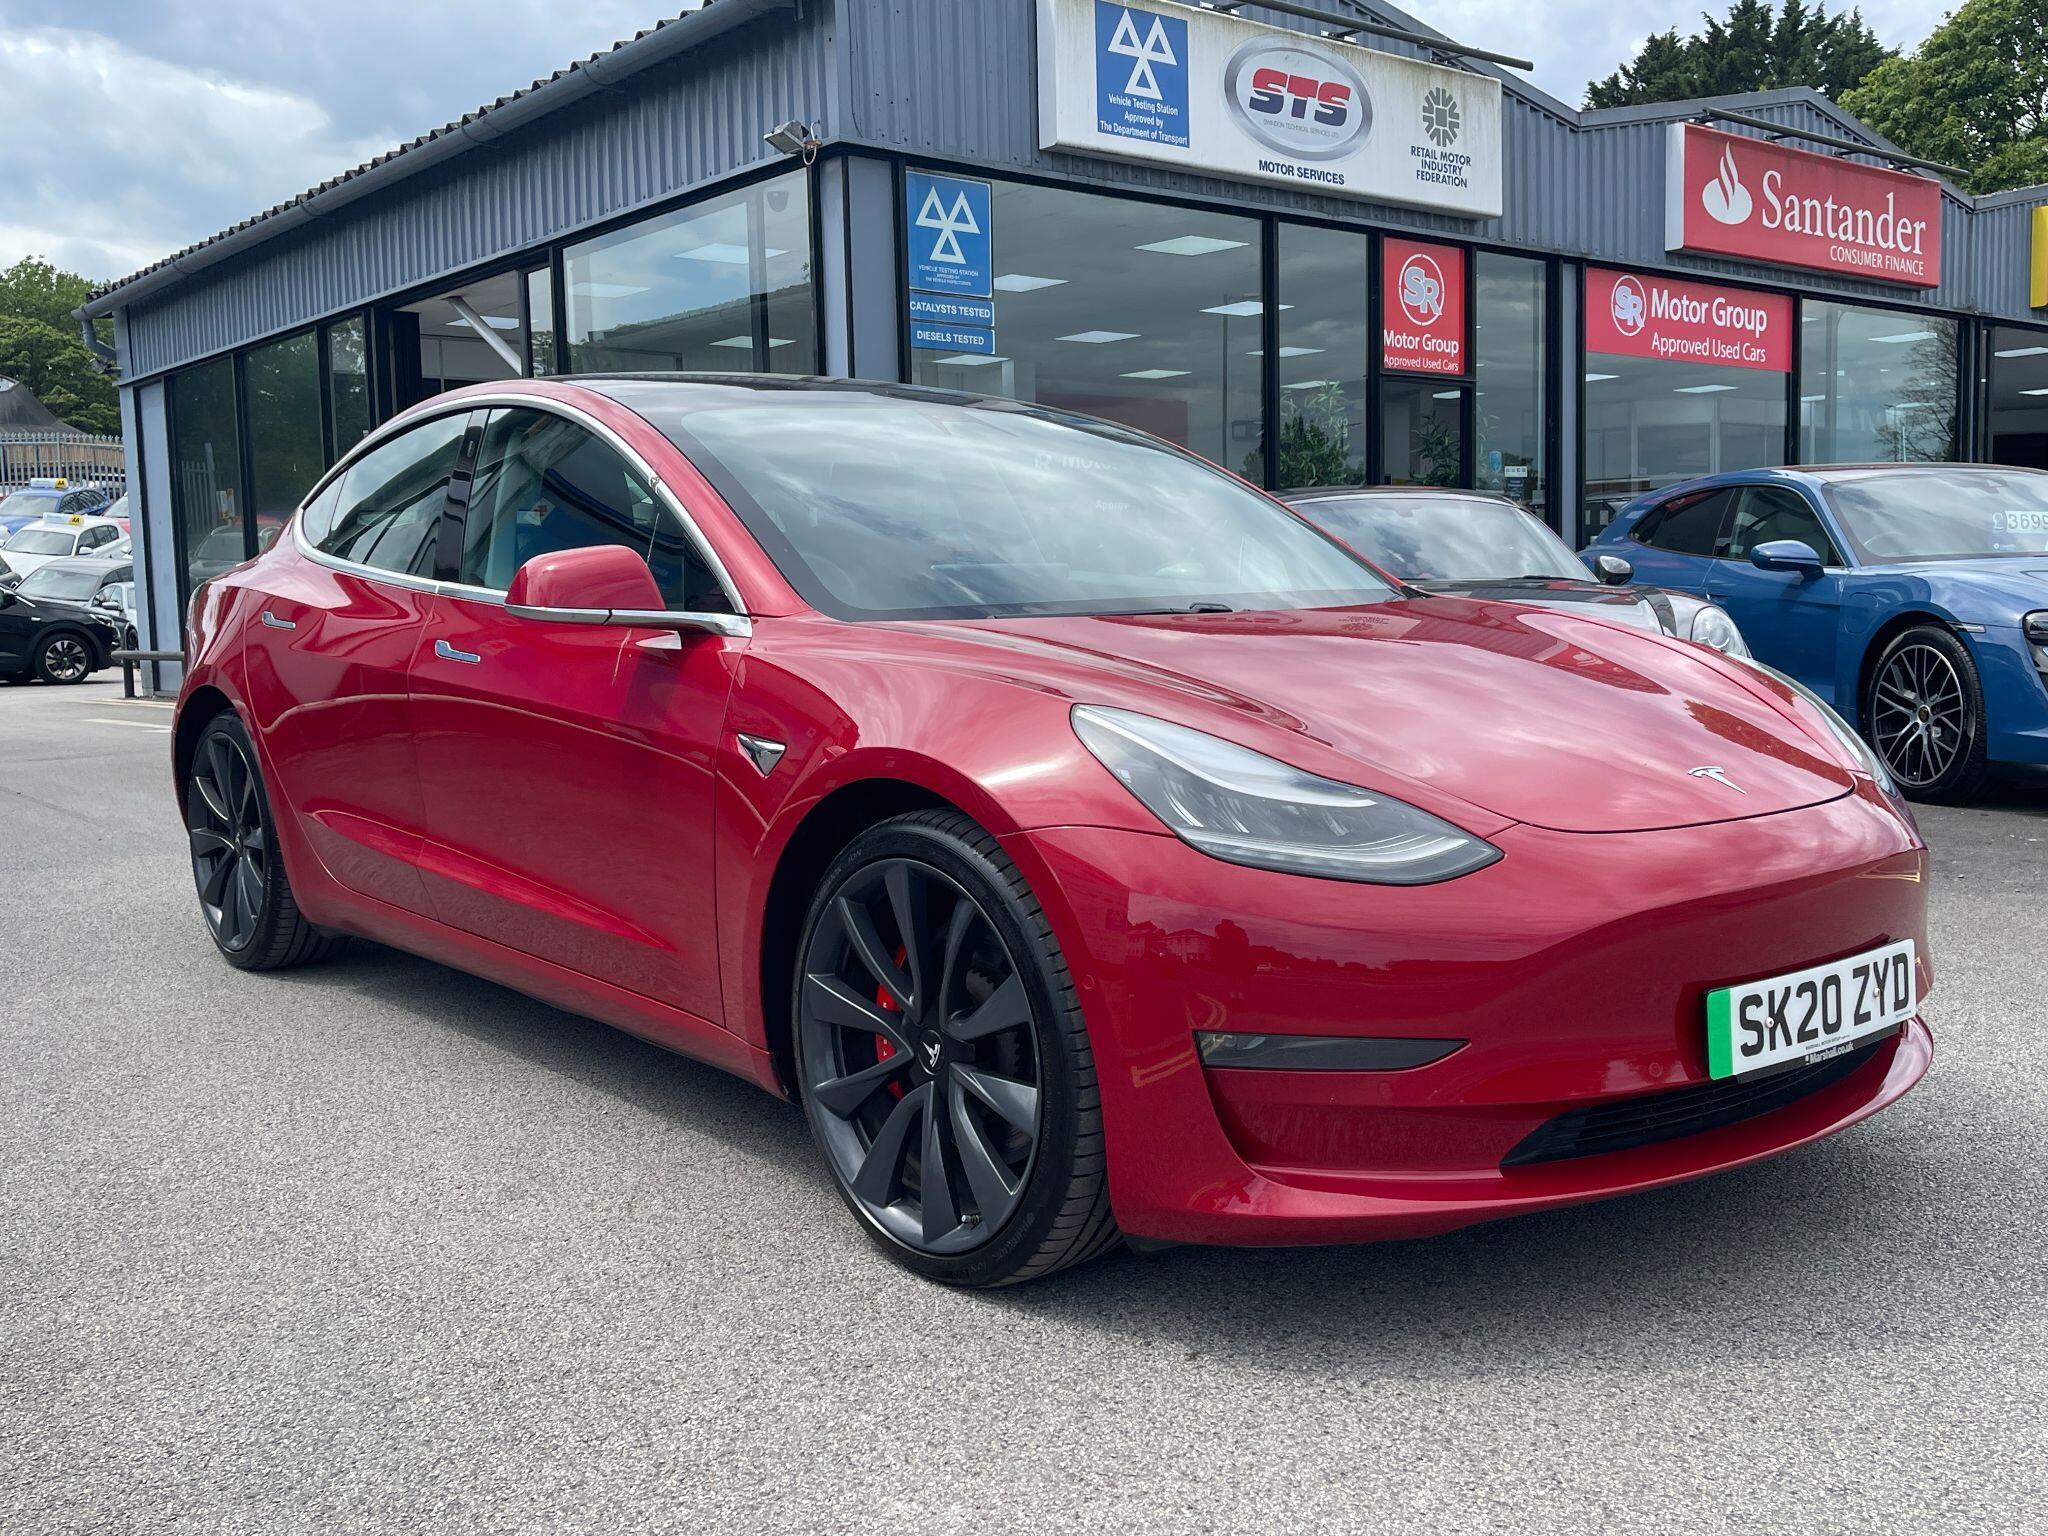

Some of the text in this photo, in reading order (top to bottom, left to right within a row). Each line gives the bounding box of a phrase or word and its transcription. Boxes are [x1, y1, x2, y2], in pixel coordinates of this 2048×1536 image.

[1108, 93, 1179, 116] Vehicle Testing Station
[1249, 68, 1351, 127] STS
[1124, 110, 1164, 129] Approved by
[1100, 120, 1188, 145] The Department of Transport
[1411, 146, 1471, 166] RETAIL MOTOR
[1421, 158, 1463, 176] INDUSTRY
[1258, 159, 1345, 186] MOTOR SERVICES
[1416, 170, 1467, 188] FEDERATION
[1762, 170, 1926, 255] Santander
[939, 267, 958, 275] TESTING
[1830, 245, 1924, 276] CONSUMER FINANCE
[909, 301, 990, 317] CATALYSTS TESTED
[1651, 287, 1768, 339] Motor Group
[916, 330, 985, 345] DIESELS TESTED
[1383, 328, 1460, 357] Motor Group
[1651, 331, 1766, 363] Approved Used Cars
[1383, 353, 1460, 372] Approved Used Cars
[1739, 953, 1909, 1057] SK20 ZYD
